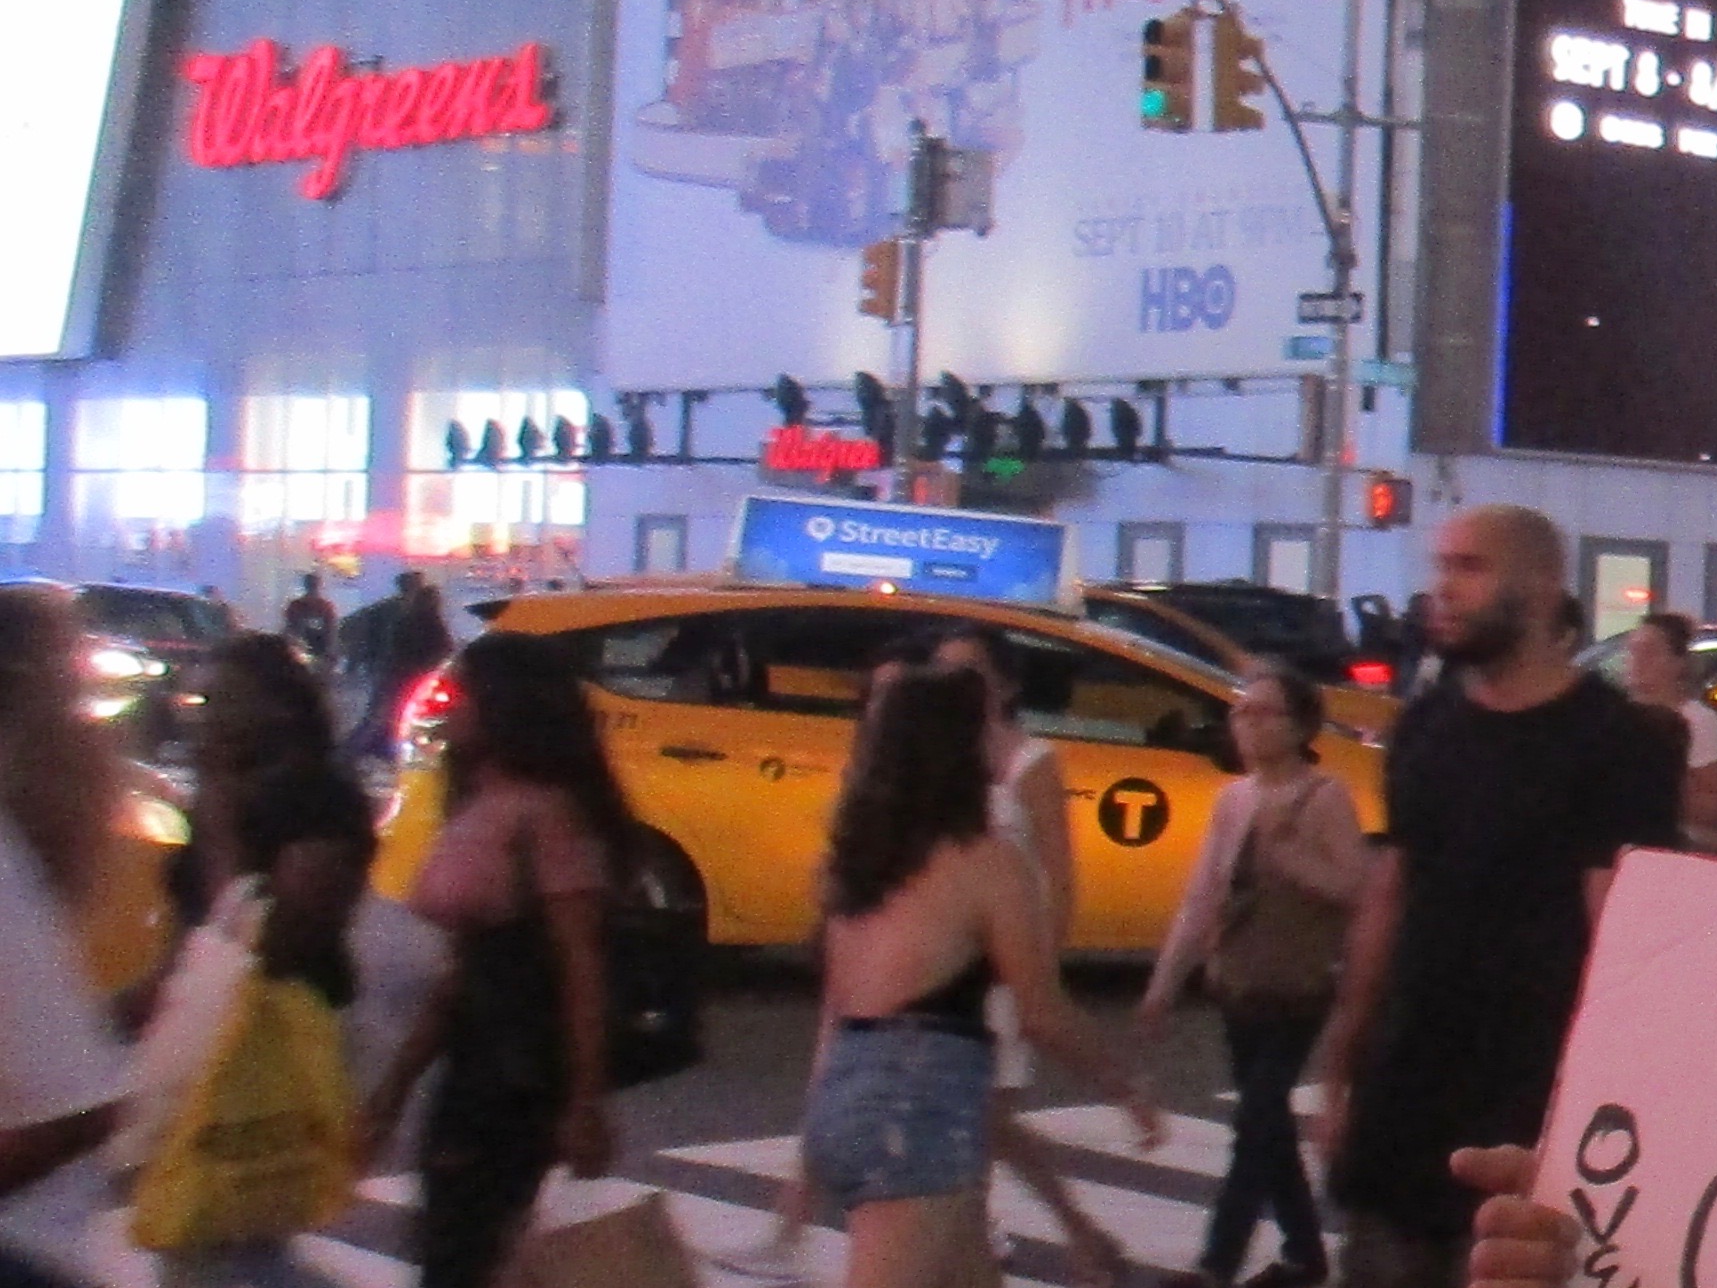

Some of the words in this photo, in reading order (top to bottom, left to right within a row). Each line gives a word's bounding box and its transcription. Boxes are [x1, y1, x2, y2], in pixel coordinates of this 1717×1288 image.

[181, 36, 555, 202] Walgreens
[1139, 265, 1235, 332] HBO
[840, 520, 1000, 560] StreetEasy
[1114, 790, 1158, 840] T
